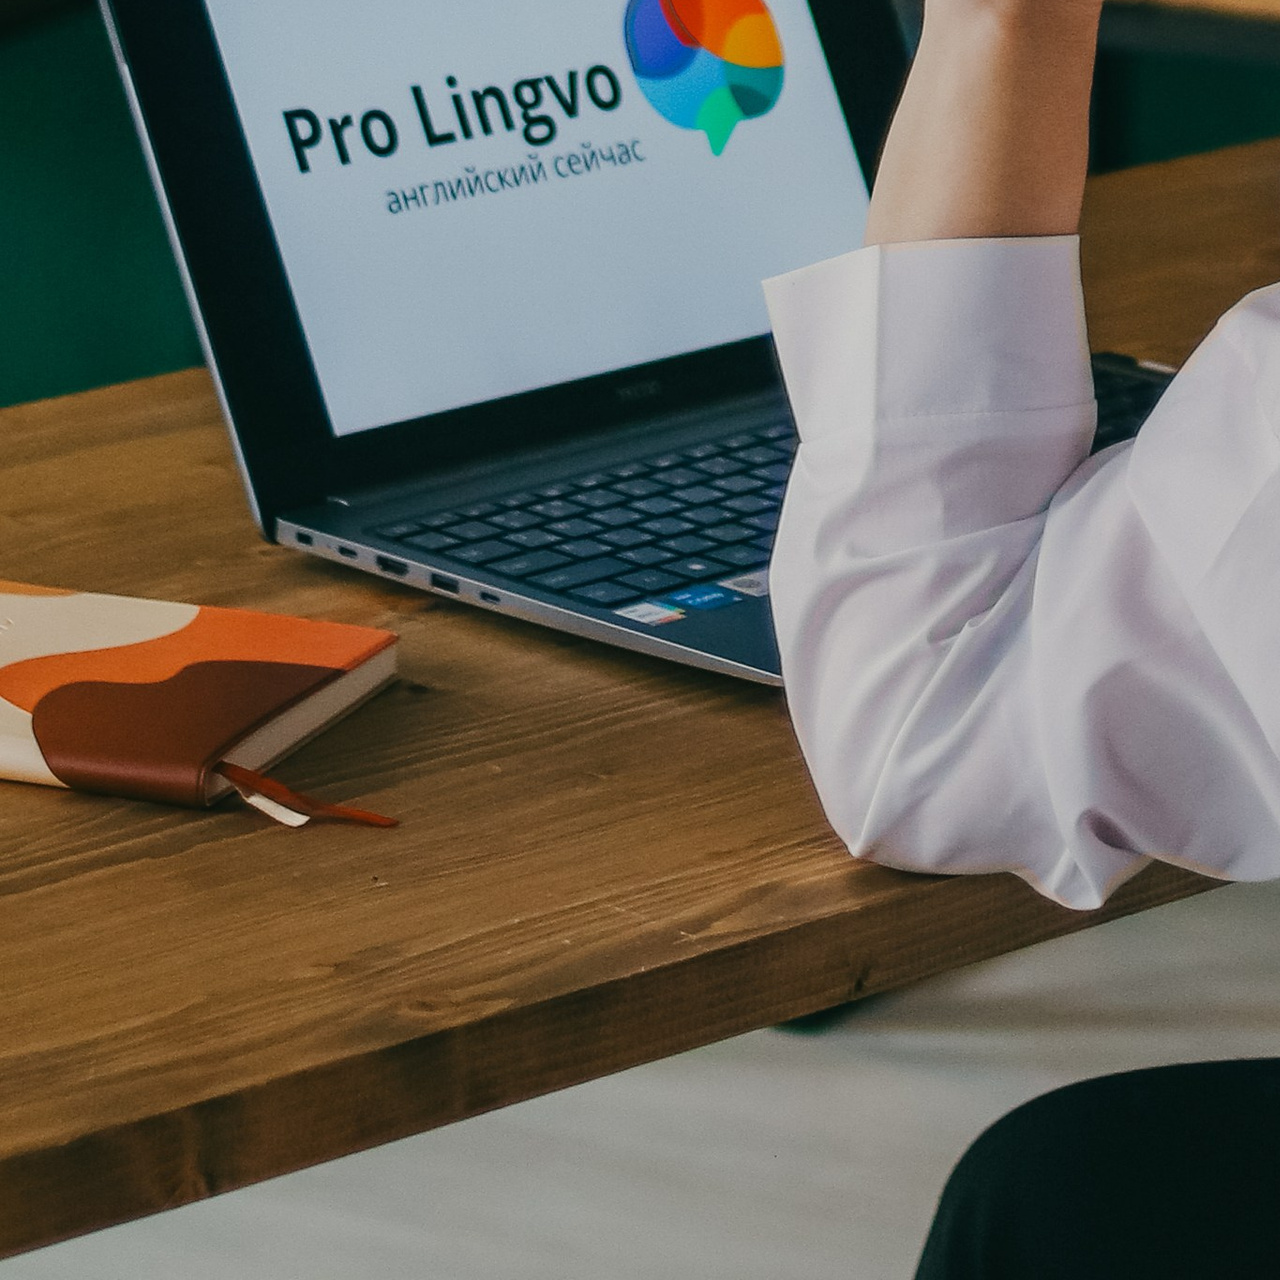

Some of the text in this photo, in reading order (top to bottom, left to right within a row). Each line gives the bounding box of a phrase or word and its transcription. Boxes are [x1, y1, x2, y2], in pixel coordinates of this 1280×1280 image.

[282, 62, 624, 175] Pro Lingvo
[386, 138, 645, 215] английский сейчас
